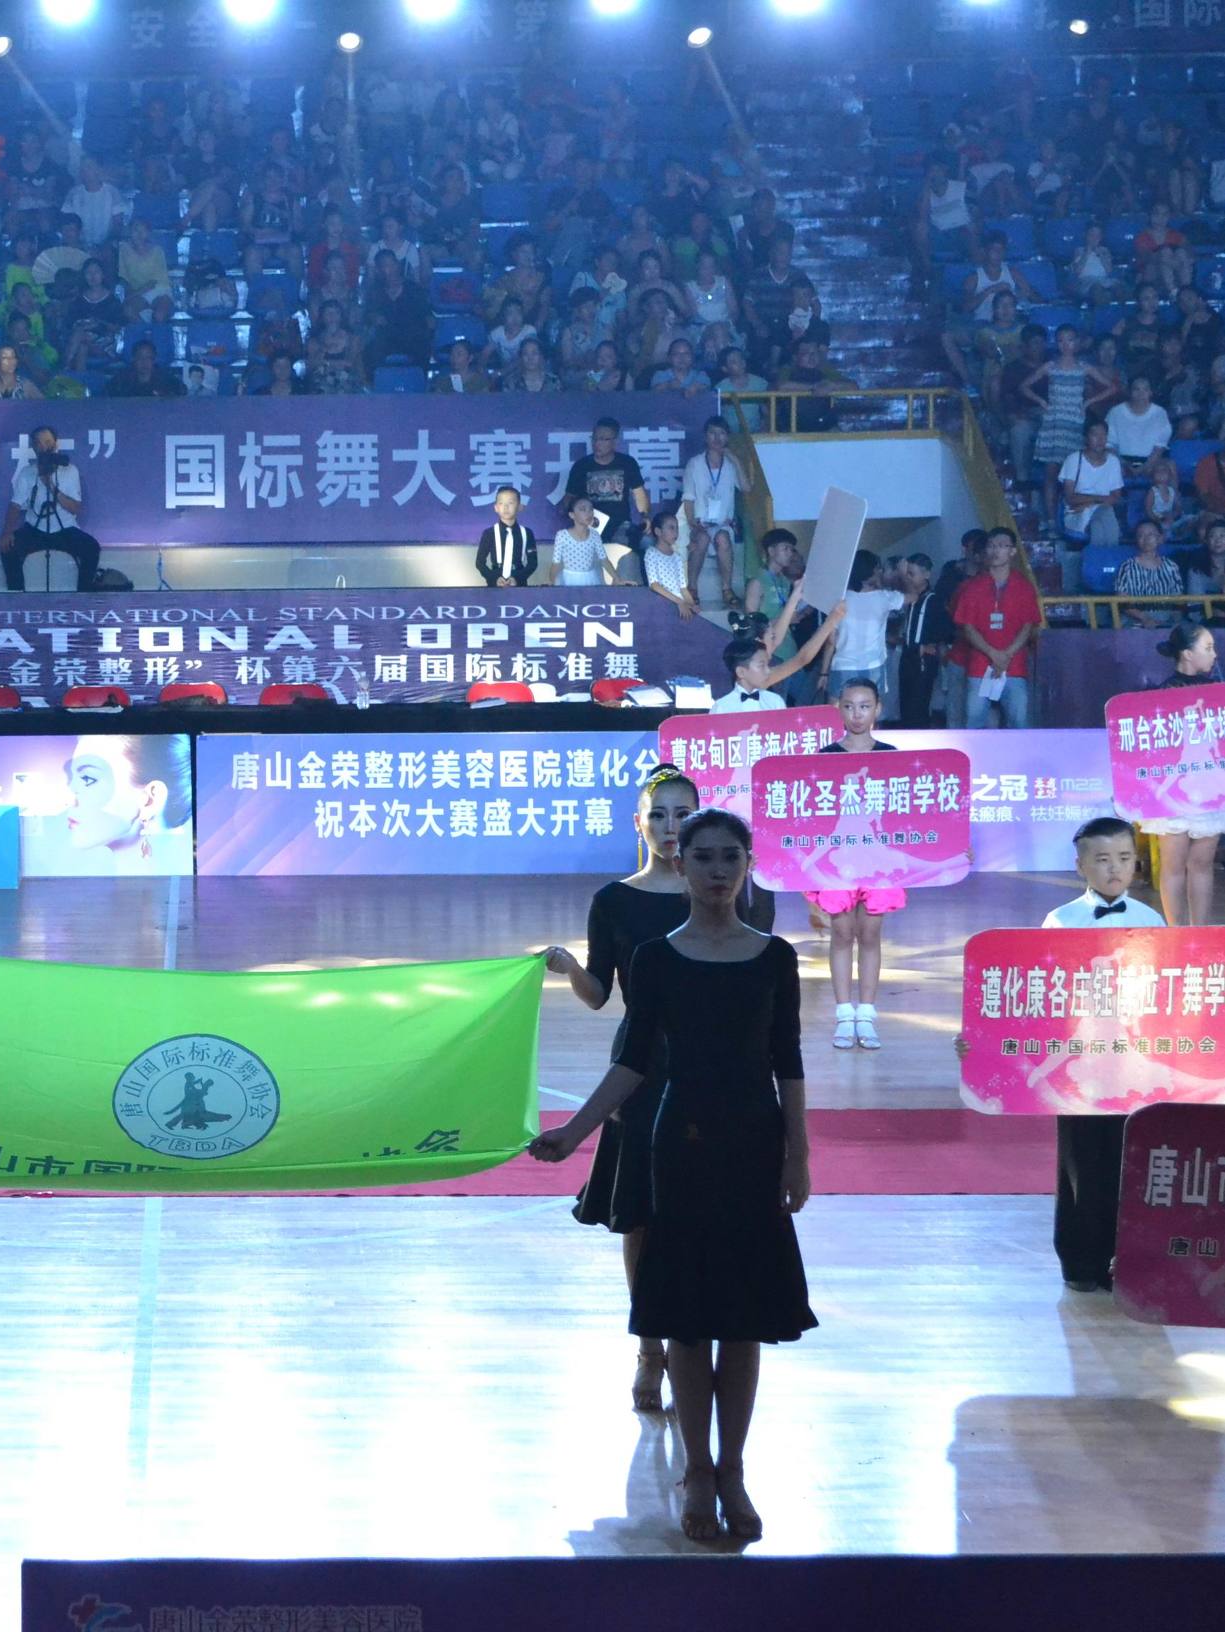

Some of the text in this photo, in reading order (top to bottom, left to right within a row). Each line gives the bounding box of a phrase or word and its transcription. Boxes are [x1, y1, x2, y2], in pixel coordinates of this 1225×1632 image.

[280, 605, 487, 622] STANDARD
[500, 603, 630, 619] DANCE
[406, 622, 634, 650] OPEN
[231, 749, 660, 790] 唐山金荣整形美容医院遵化分
[765, 774, 961, 819] 遵化圣杰舞蹈学校
[972, 774, 1028, 801] 之冠
[315, 798, 614, 838] 祝本次大赛盛大开幕
[782, 831, 939, 848] 唐山市国际标准舞协会
[1002, 1037, 1214, 1055] 唐山市国际标准舞协会
[148, 1135, 246, 1152] TBDA
